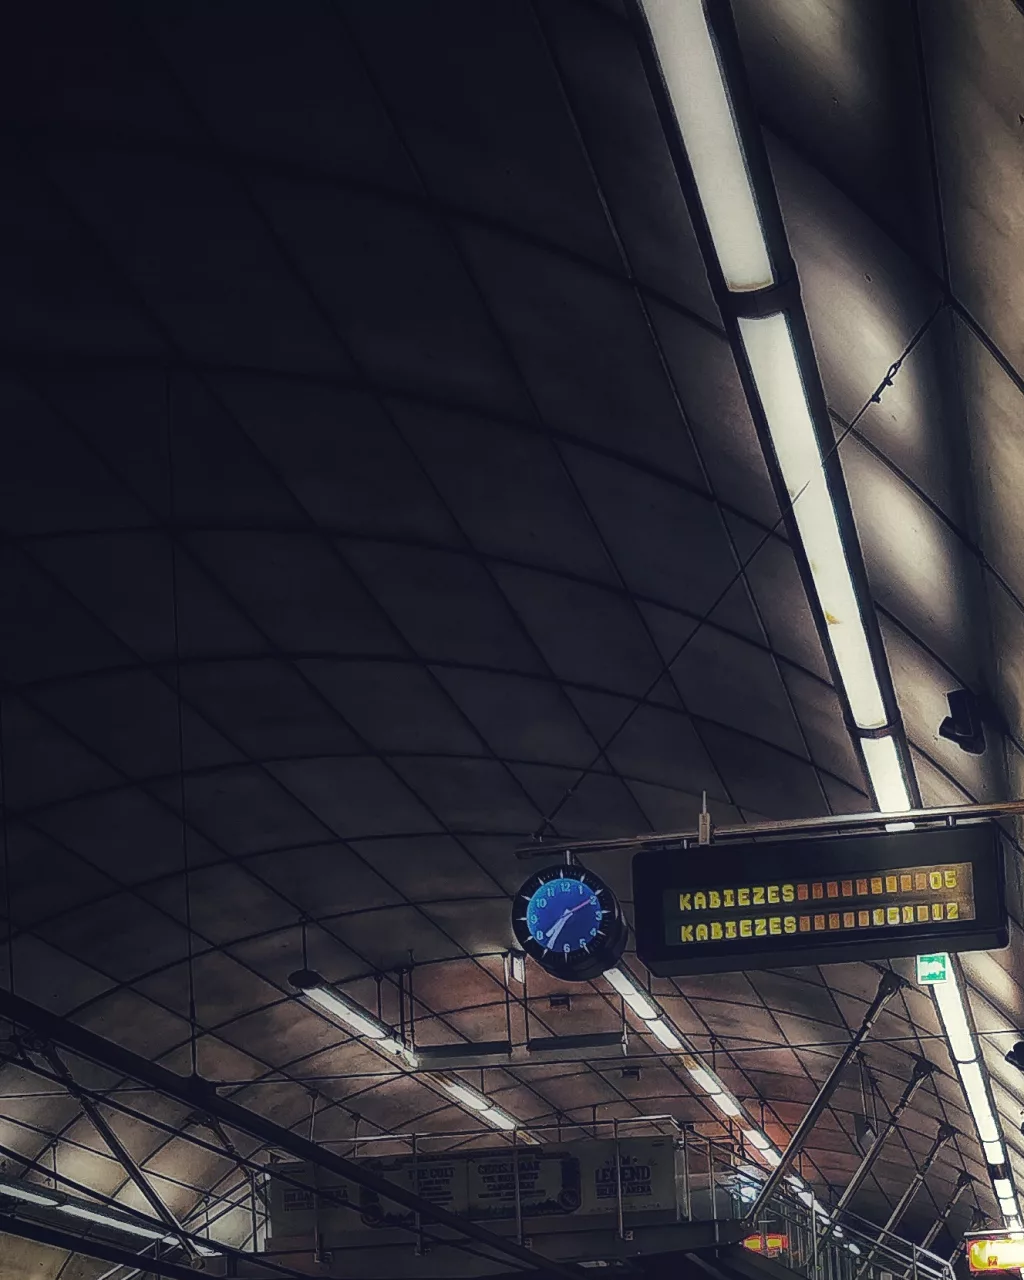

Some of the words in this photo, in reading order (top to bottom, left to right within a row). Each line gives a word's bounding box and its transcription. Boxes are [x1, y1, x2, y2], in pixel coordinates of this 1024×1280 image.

[680, 884, 795, 911] KABIEZES
[929, 869, 957, 890] 05
[681, 915, 797, 942] KABIEZES
[932, 902, 959, 920] 12
[430, 1166, 456, 1179] CULT
